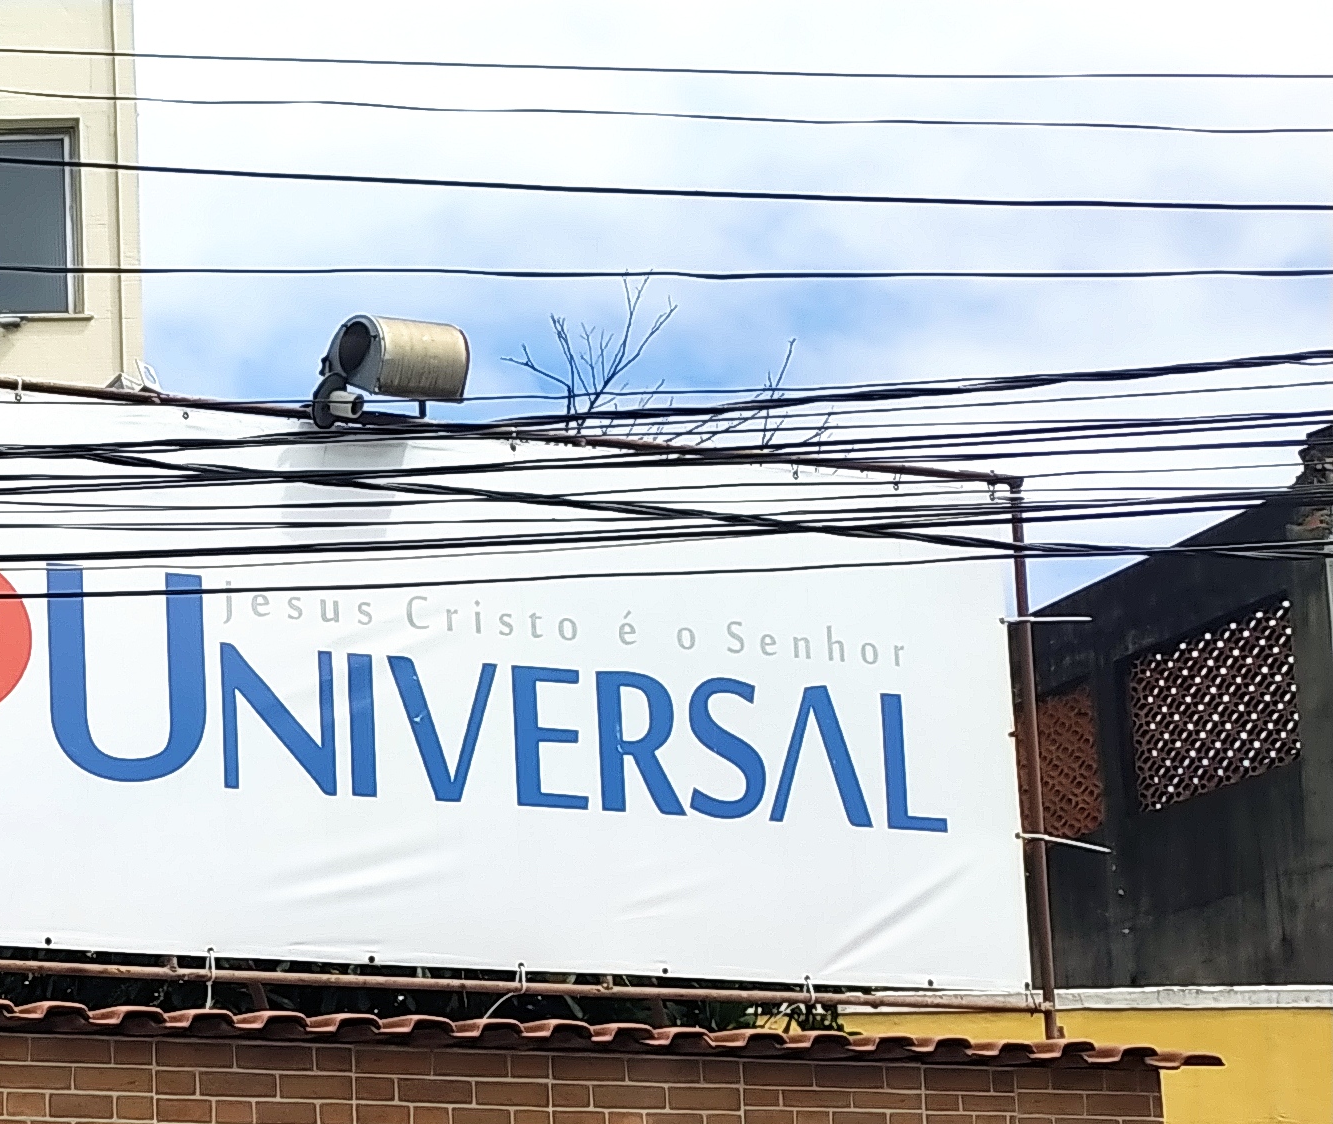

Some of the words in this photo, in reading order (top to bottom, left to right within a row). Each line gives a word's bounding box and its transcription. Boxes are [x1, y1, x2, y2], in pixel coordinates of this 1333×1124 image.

[46, 562, 948, 833] UNIVERSAL
[406, 595, 579, 641] Cristo
[618, 611, 637, 645] é
[676, 627, 696, 650] o
[726, 621, 905, 667] Senhor
